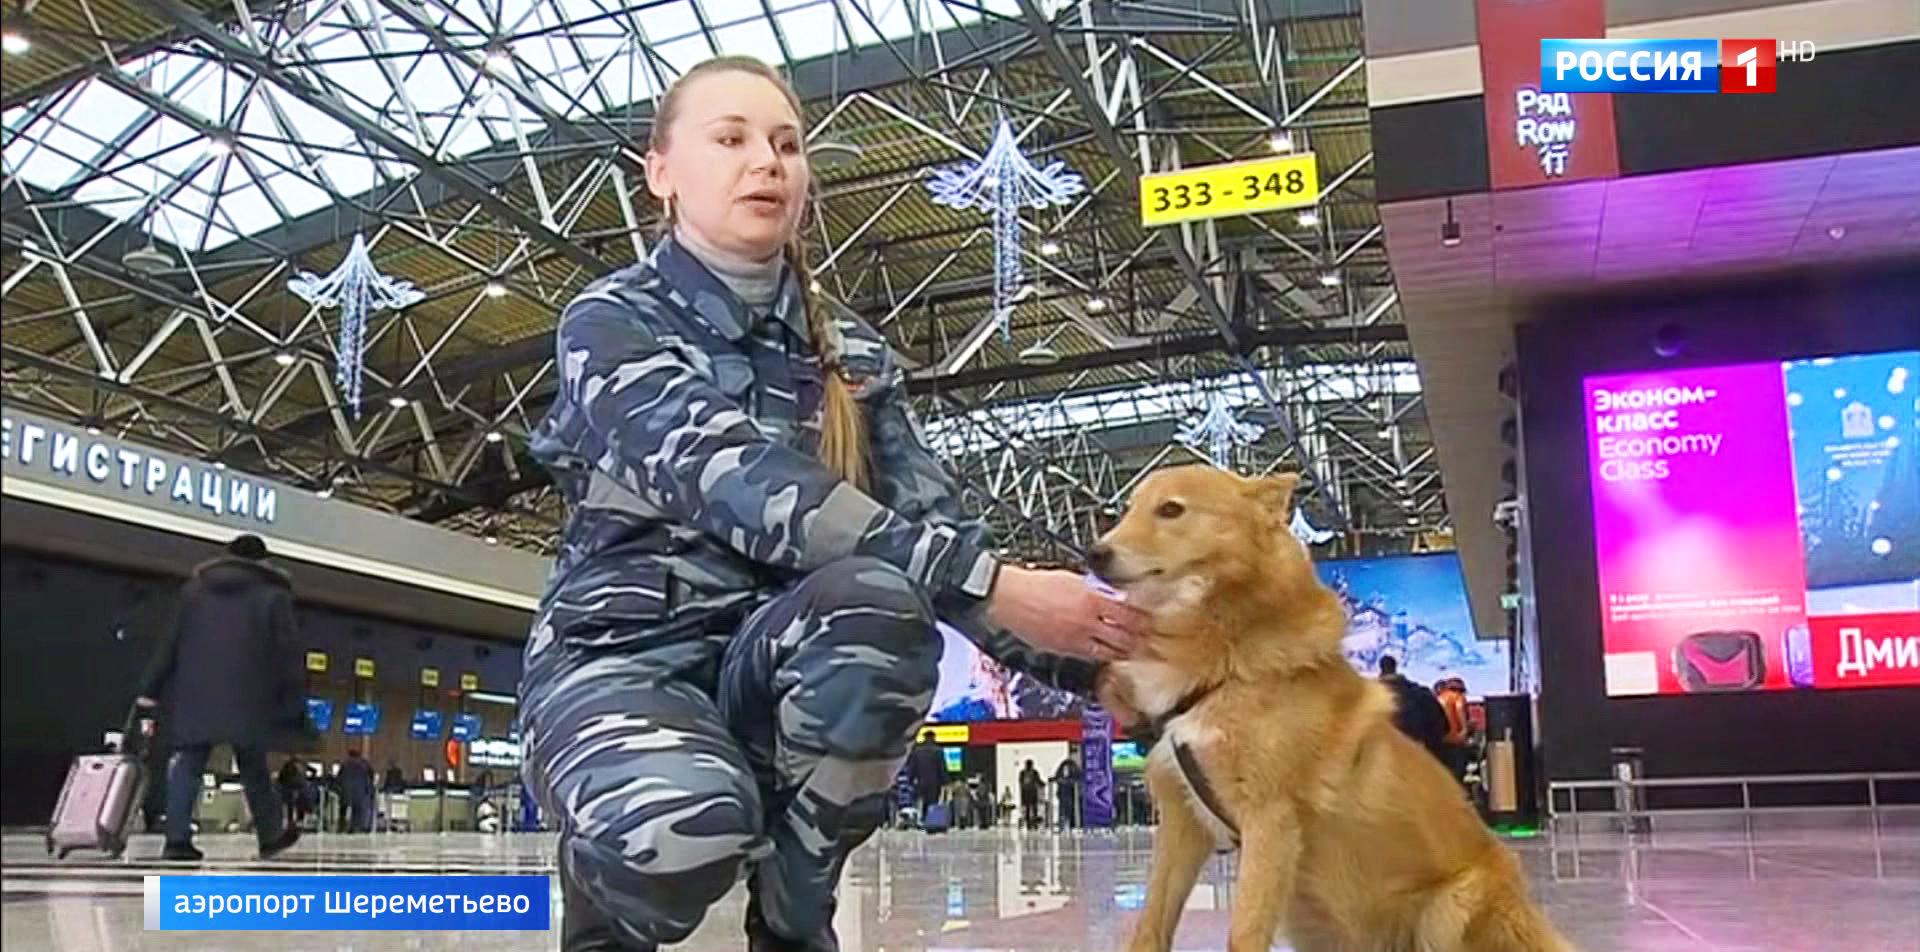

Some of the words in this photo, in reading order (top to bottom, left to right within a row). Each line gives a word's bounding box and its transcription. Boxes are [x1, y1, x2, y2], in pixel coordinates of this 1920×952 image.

[1517, 118, 1575, 146] Row
[1539, 143, 1568, 176] 行
[1153, 182, 1212, 212] 333
[1243, 169, 1304, 201] 348
[1593, 385, 1717, 412] Эконом-
[1597, 410, 1679, 433] класс
[1600, 433, 1722, 458] Economy
[1600, 459, 1670, 481] Class
[1837, 627, 1920, 678] Дми
